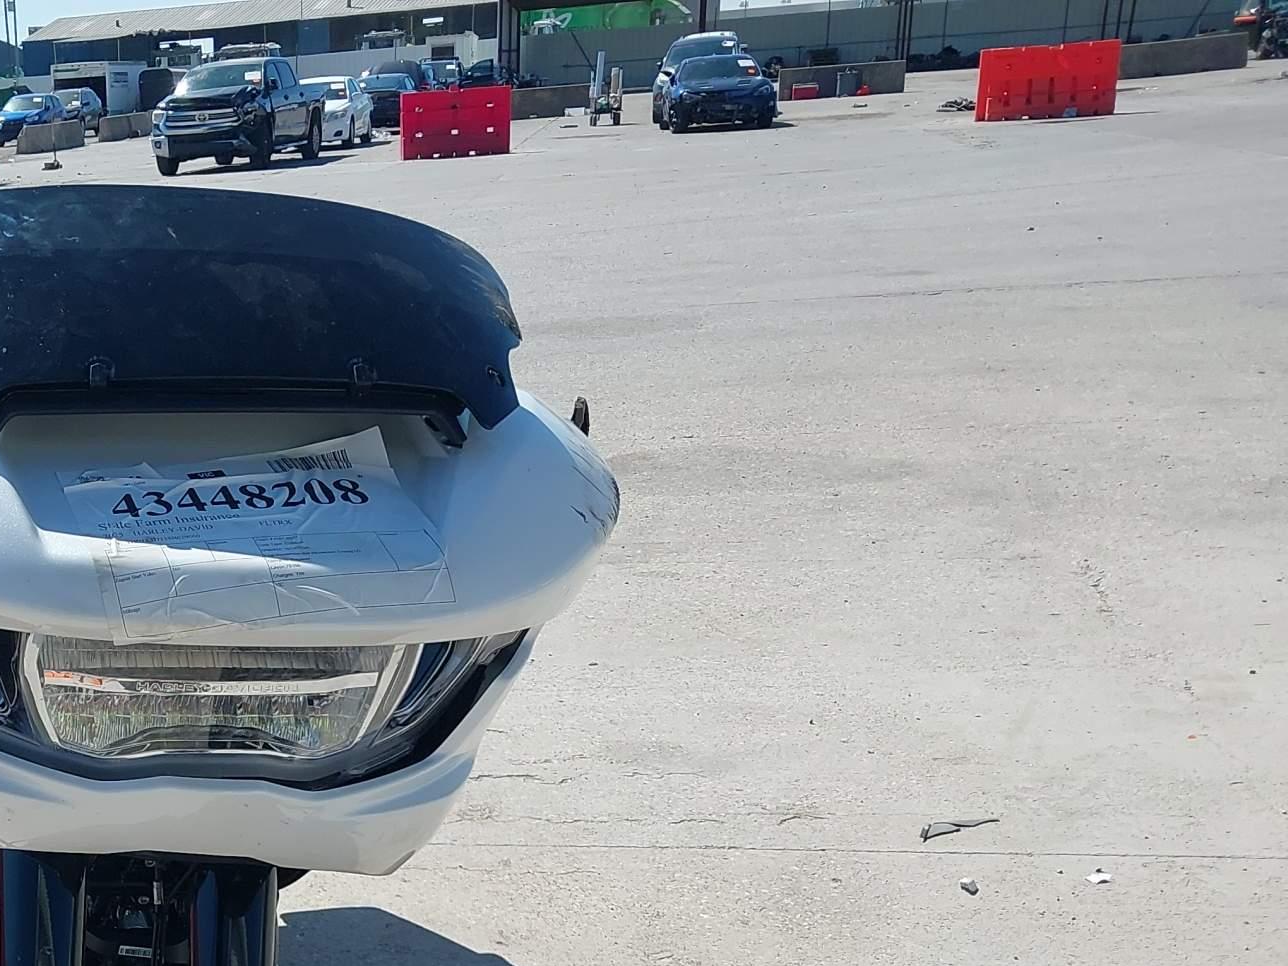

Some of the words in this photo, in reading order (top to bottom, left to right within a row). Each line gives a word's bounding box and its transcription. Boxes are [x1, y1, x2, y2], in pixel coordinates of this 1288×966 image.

[112, 478, 369, 518] 43448208
[98, 521, 132, 531] State
[135, 518, 171, 528] Farm
[175, 513, 241, 524] Insurance
